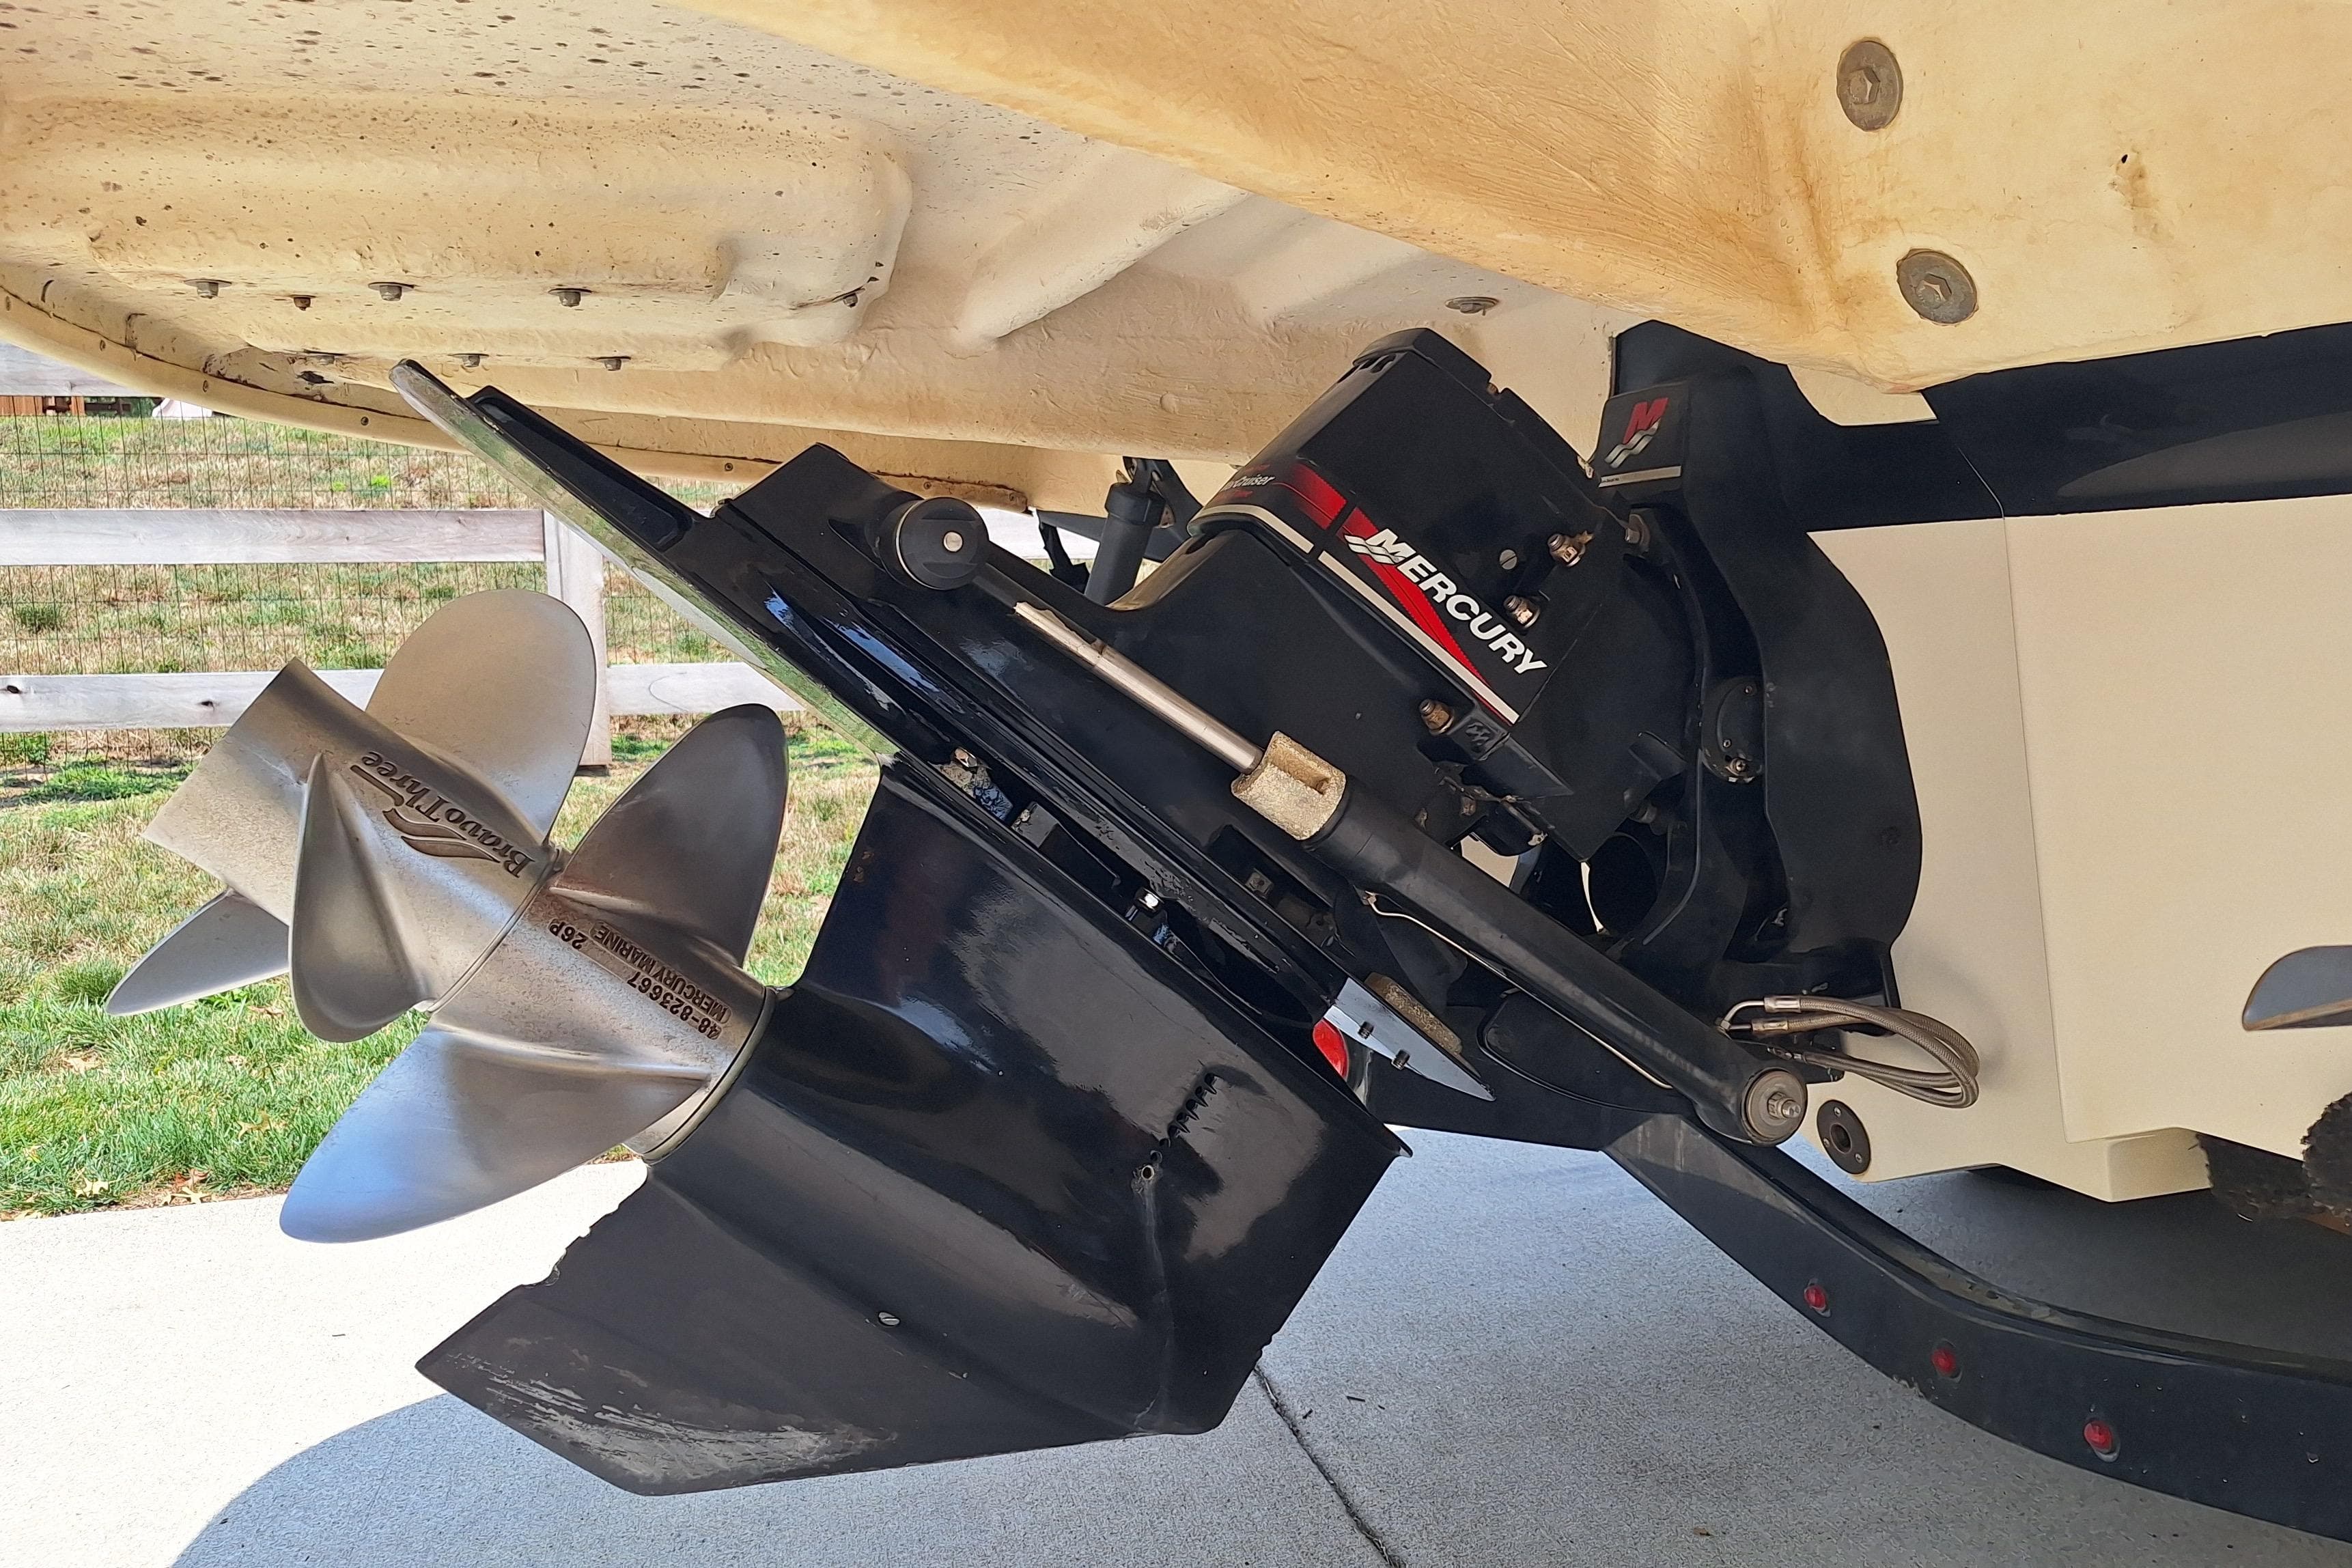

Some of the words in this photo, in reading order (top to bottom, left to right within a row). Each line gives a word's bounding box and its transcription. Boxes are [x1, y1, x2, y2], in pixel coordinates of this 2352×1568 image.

[1364, 528, 1548, 675] MERCURY
[361, 751, 535, 878] BravoThree
[549, 921, 588, 949] 26P
[593, 924, 656, 975] MARINE
[627, 971, 722, 1040] 48-823667
[652, 965, 730, 1022] MERCURY
